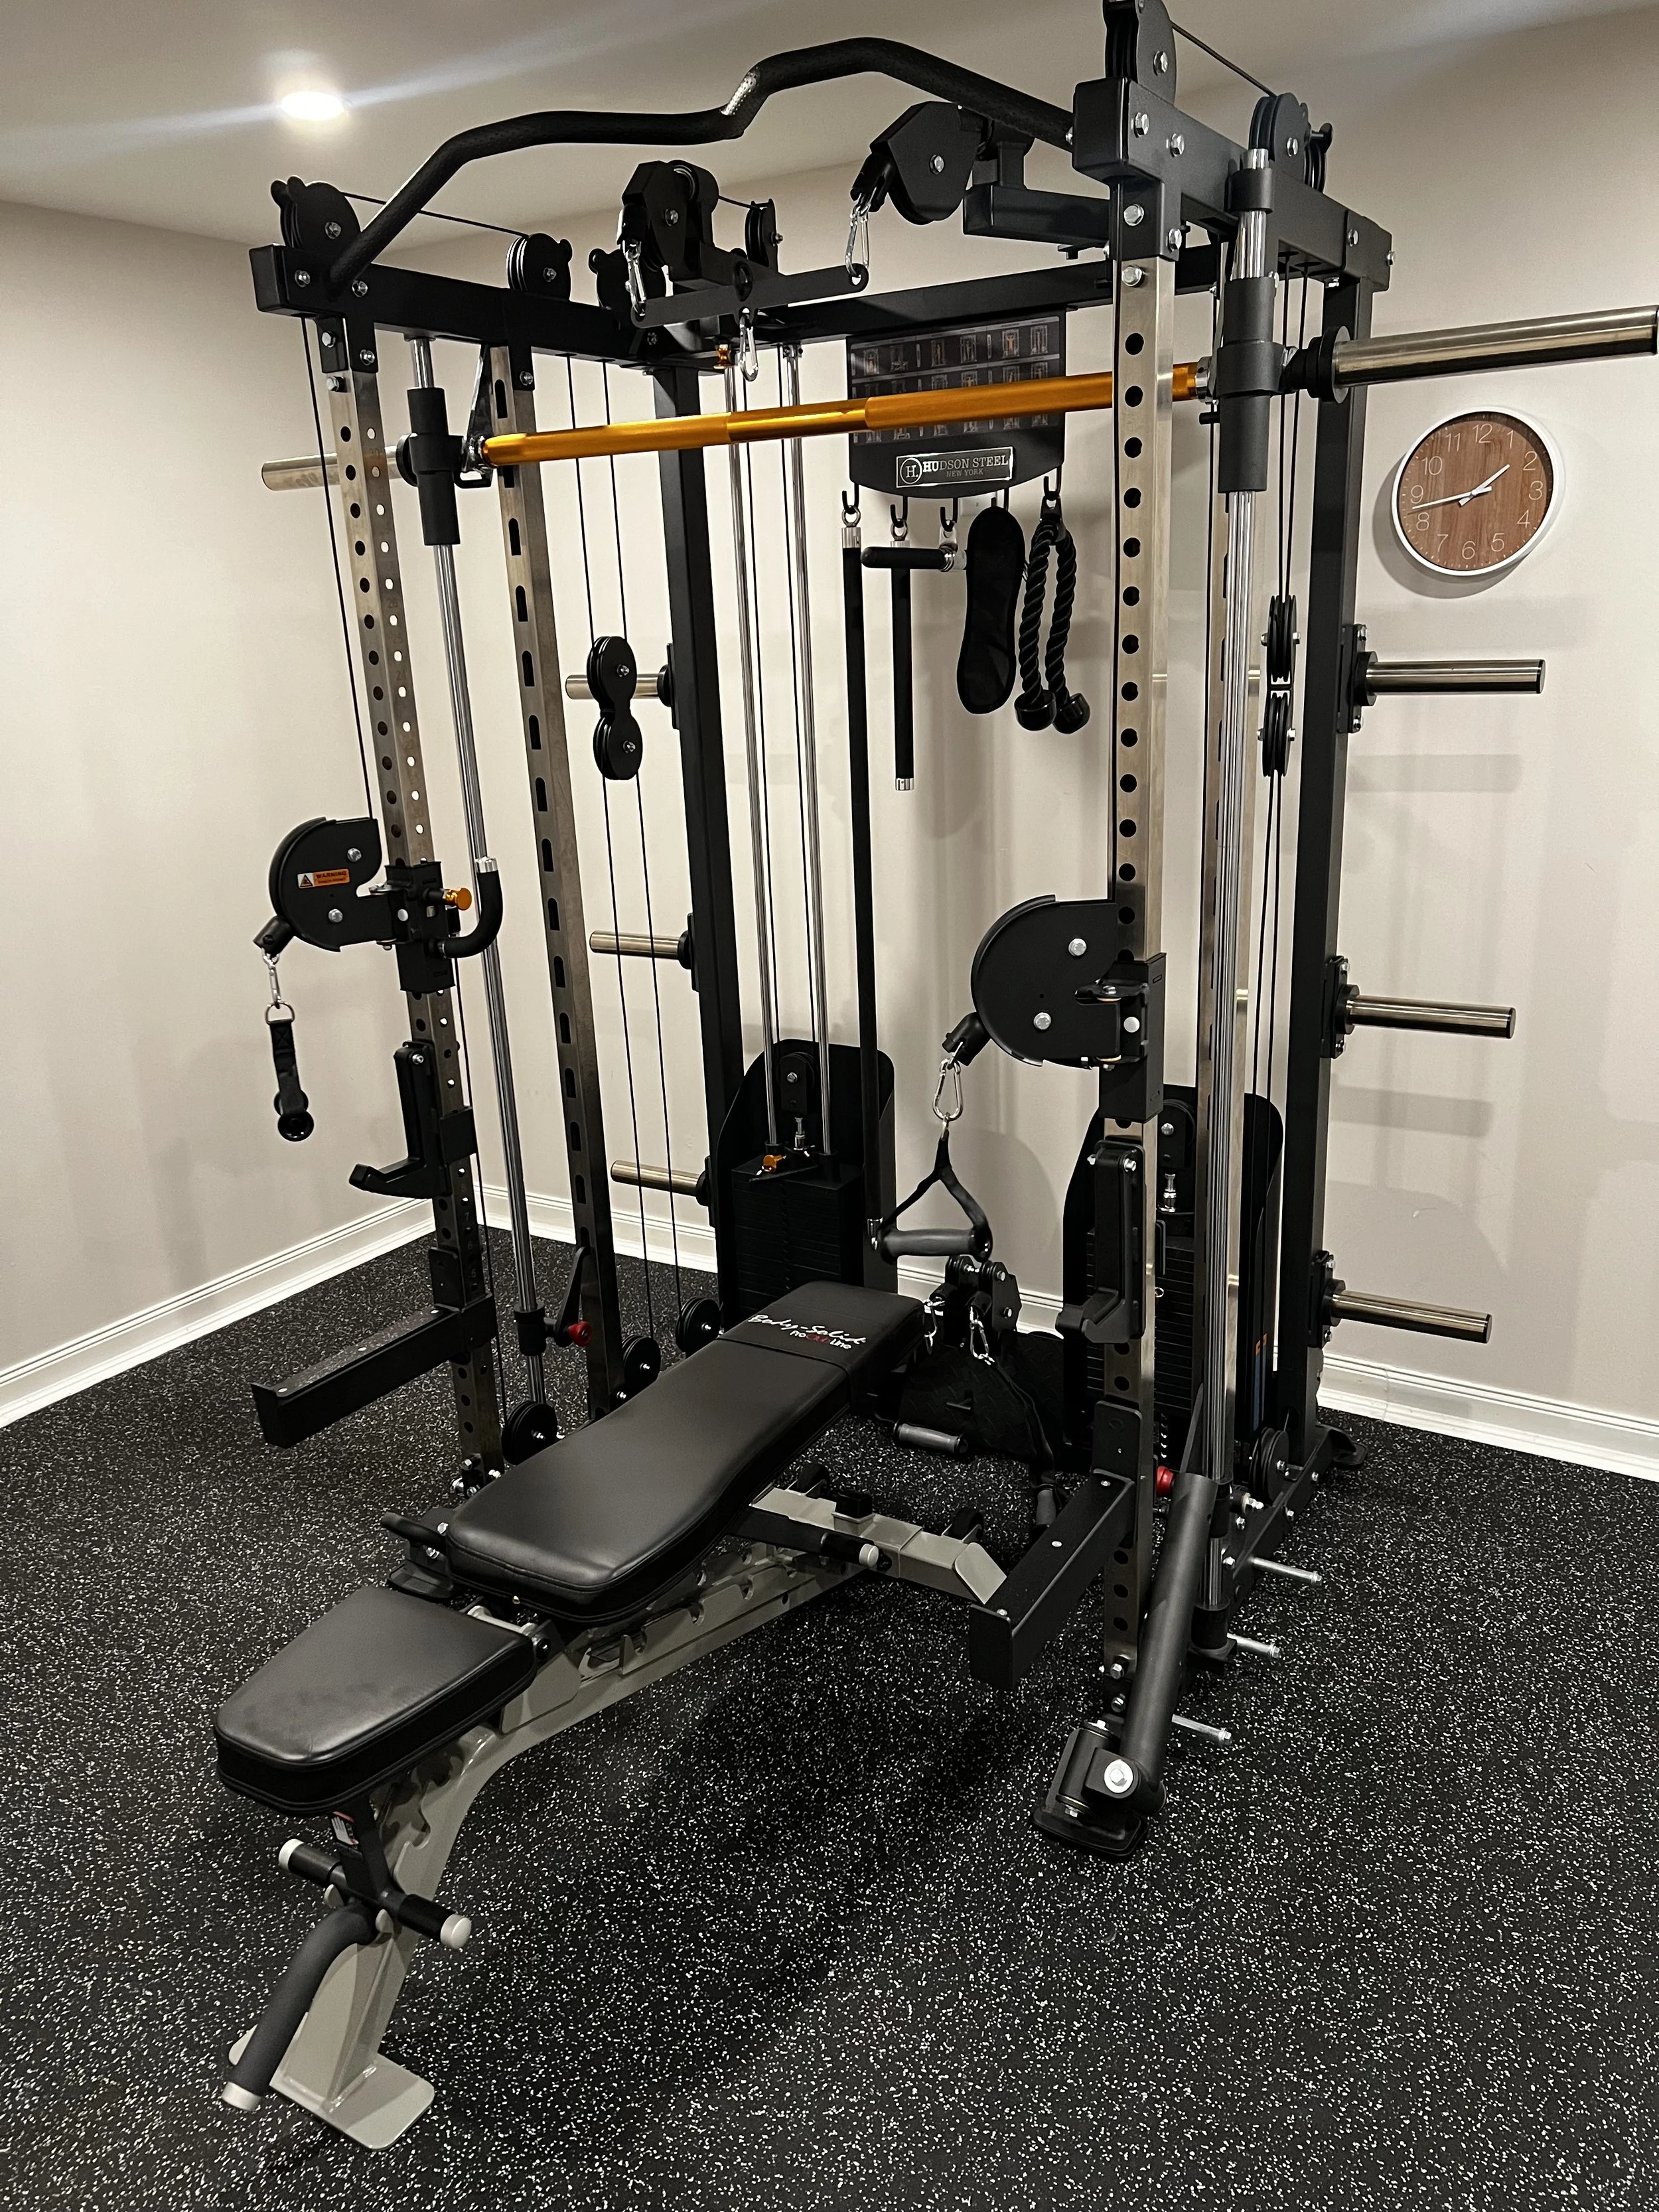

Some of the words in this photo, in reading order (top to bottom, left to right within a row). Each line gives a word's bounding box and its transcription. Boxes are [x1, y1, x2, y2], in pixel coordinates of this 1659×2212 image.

[1445, 433, 1461, 452] 11
[1473, 423, 1493, 444] 12
[1506, 430, 1514, 449] 1
[922, 458, 970, 473] HUDSON
[972, 455, 1009, 468] STEEL
[1422, 456, 1443, 476] 10
[1522, 450, 1538, 471] 2
[946, 469, 963, 478] NEW
[964, 468, 984, 477] YORK
[1410, 485, 1423, 504] 9
[1528, 480, 1543, 501] 3
[1416, 512, 1429, 532] 8
[1517, 510, 1530, 528] 4
[1437, 534, 1449, 553] 7
[1462, 540, 1475, 559] 6
[1490, 533, 1505, 552] 5
[748, 1315, 867, 1345] Body-Solid
